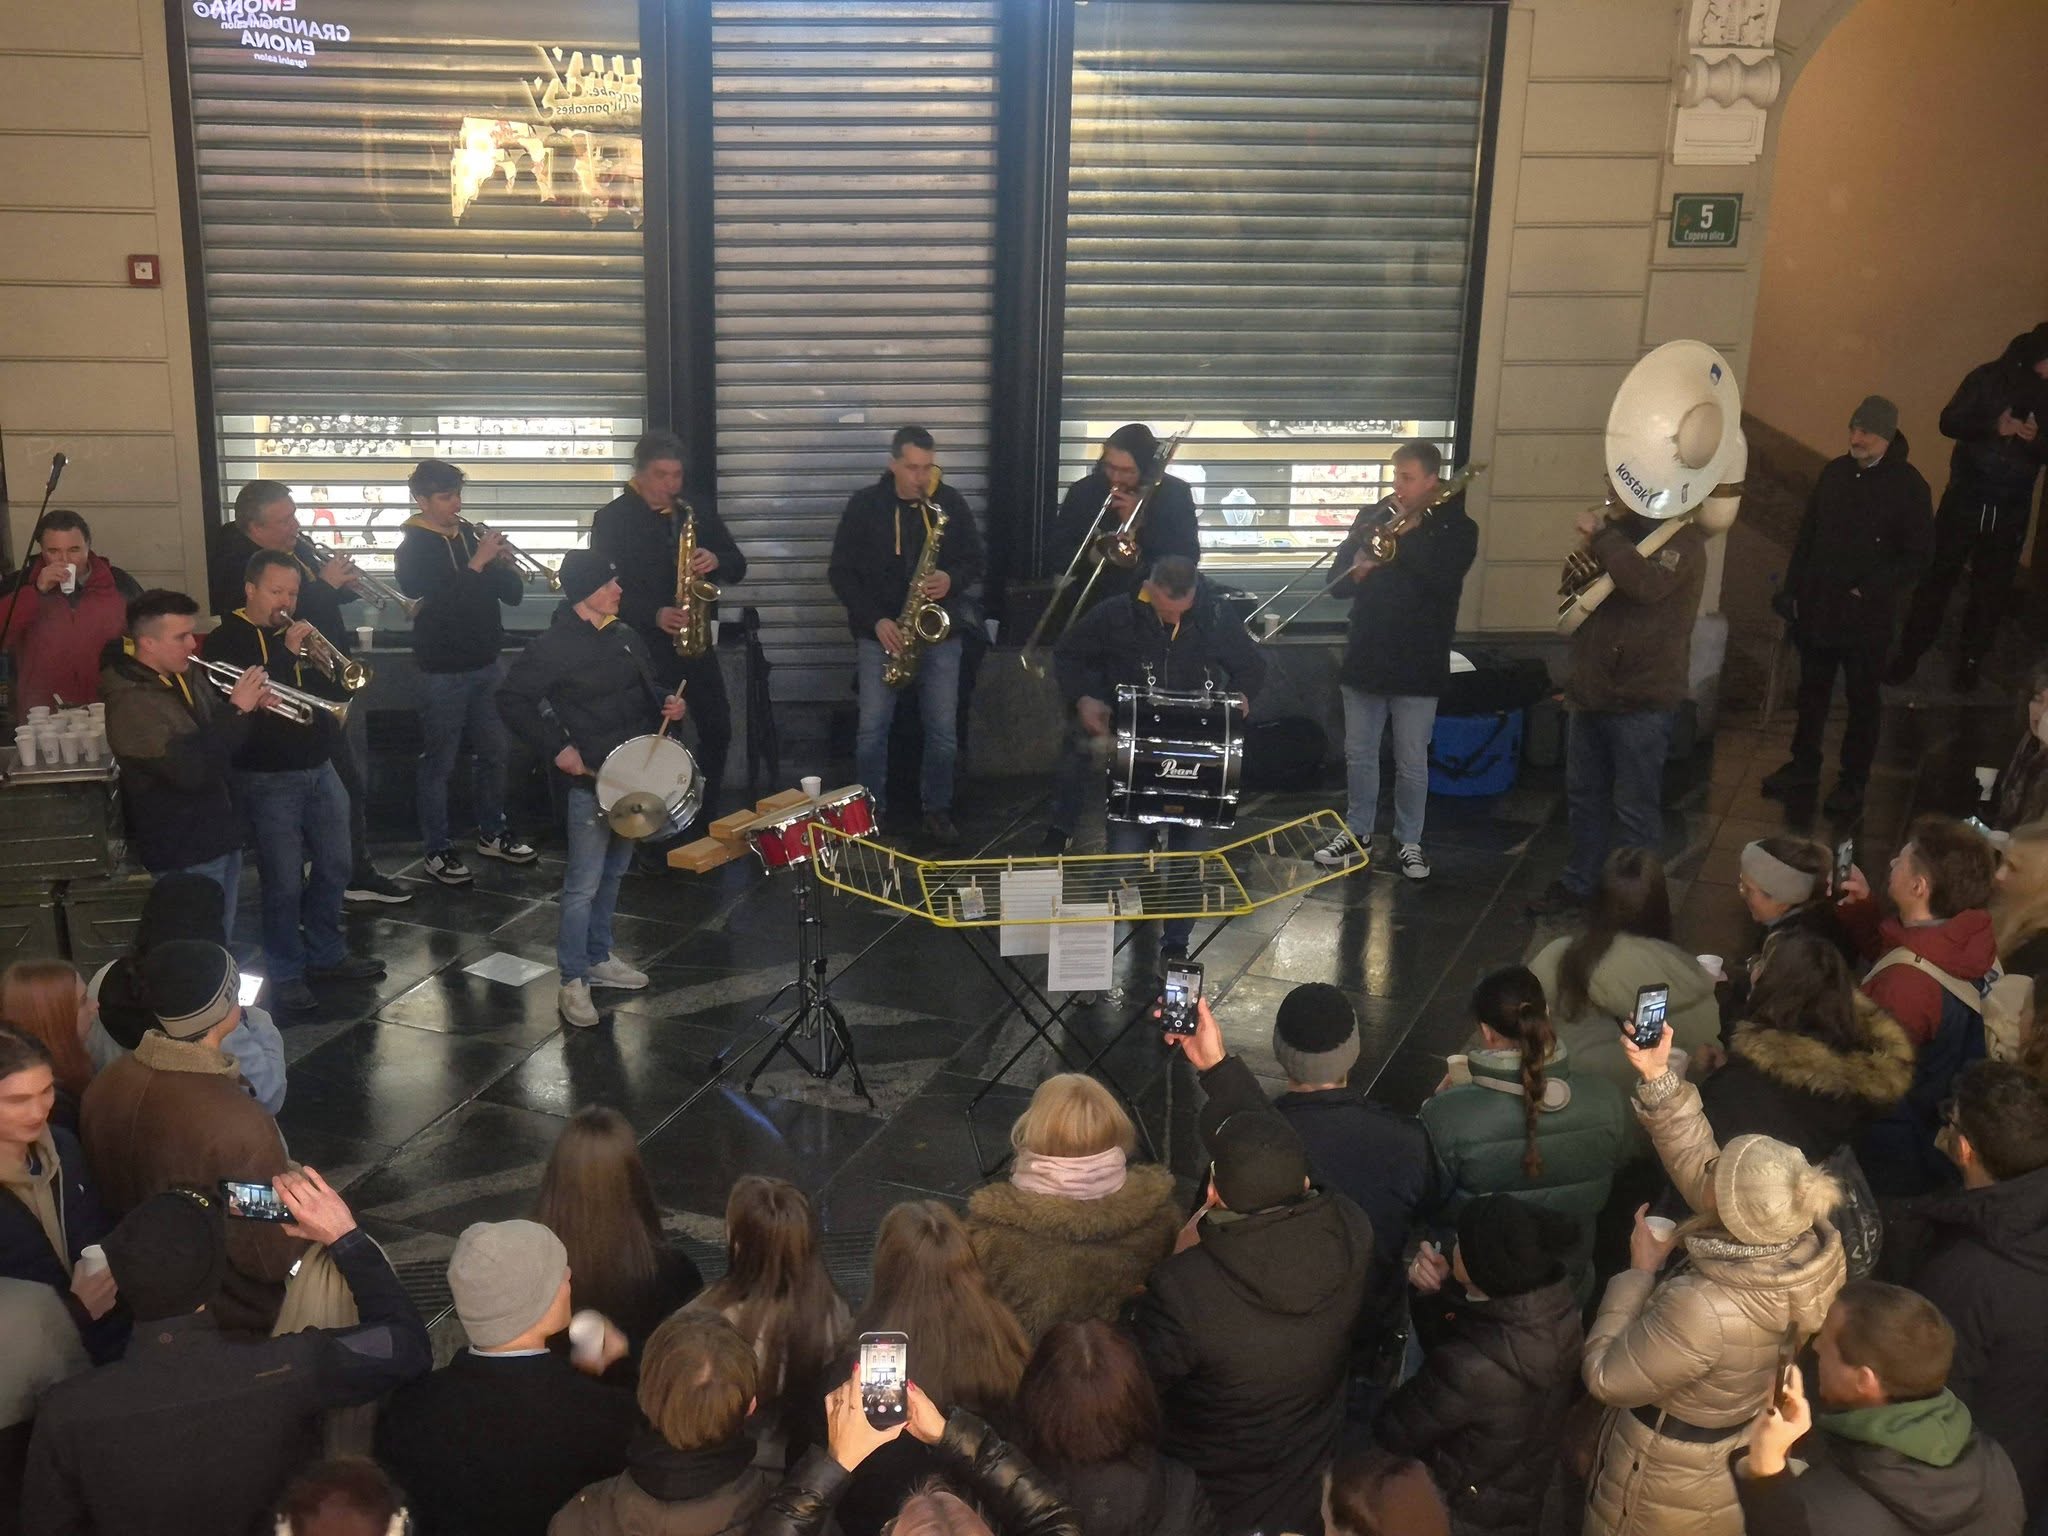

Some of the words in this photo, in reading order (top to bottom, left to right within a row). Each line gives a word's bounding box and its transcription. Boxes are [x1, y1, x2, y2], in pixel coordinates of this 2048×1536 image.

[1700, 204, 1714, 229] 5
[1615, 462, 1650, 503] kostak
[1155, 758, 1201, 779] Pearl
